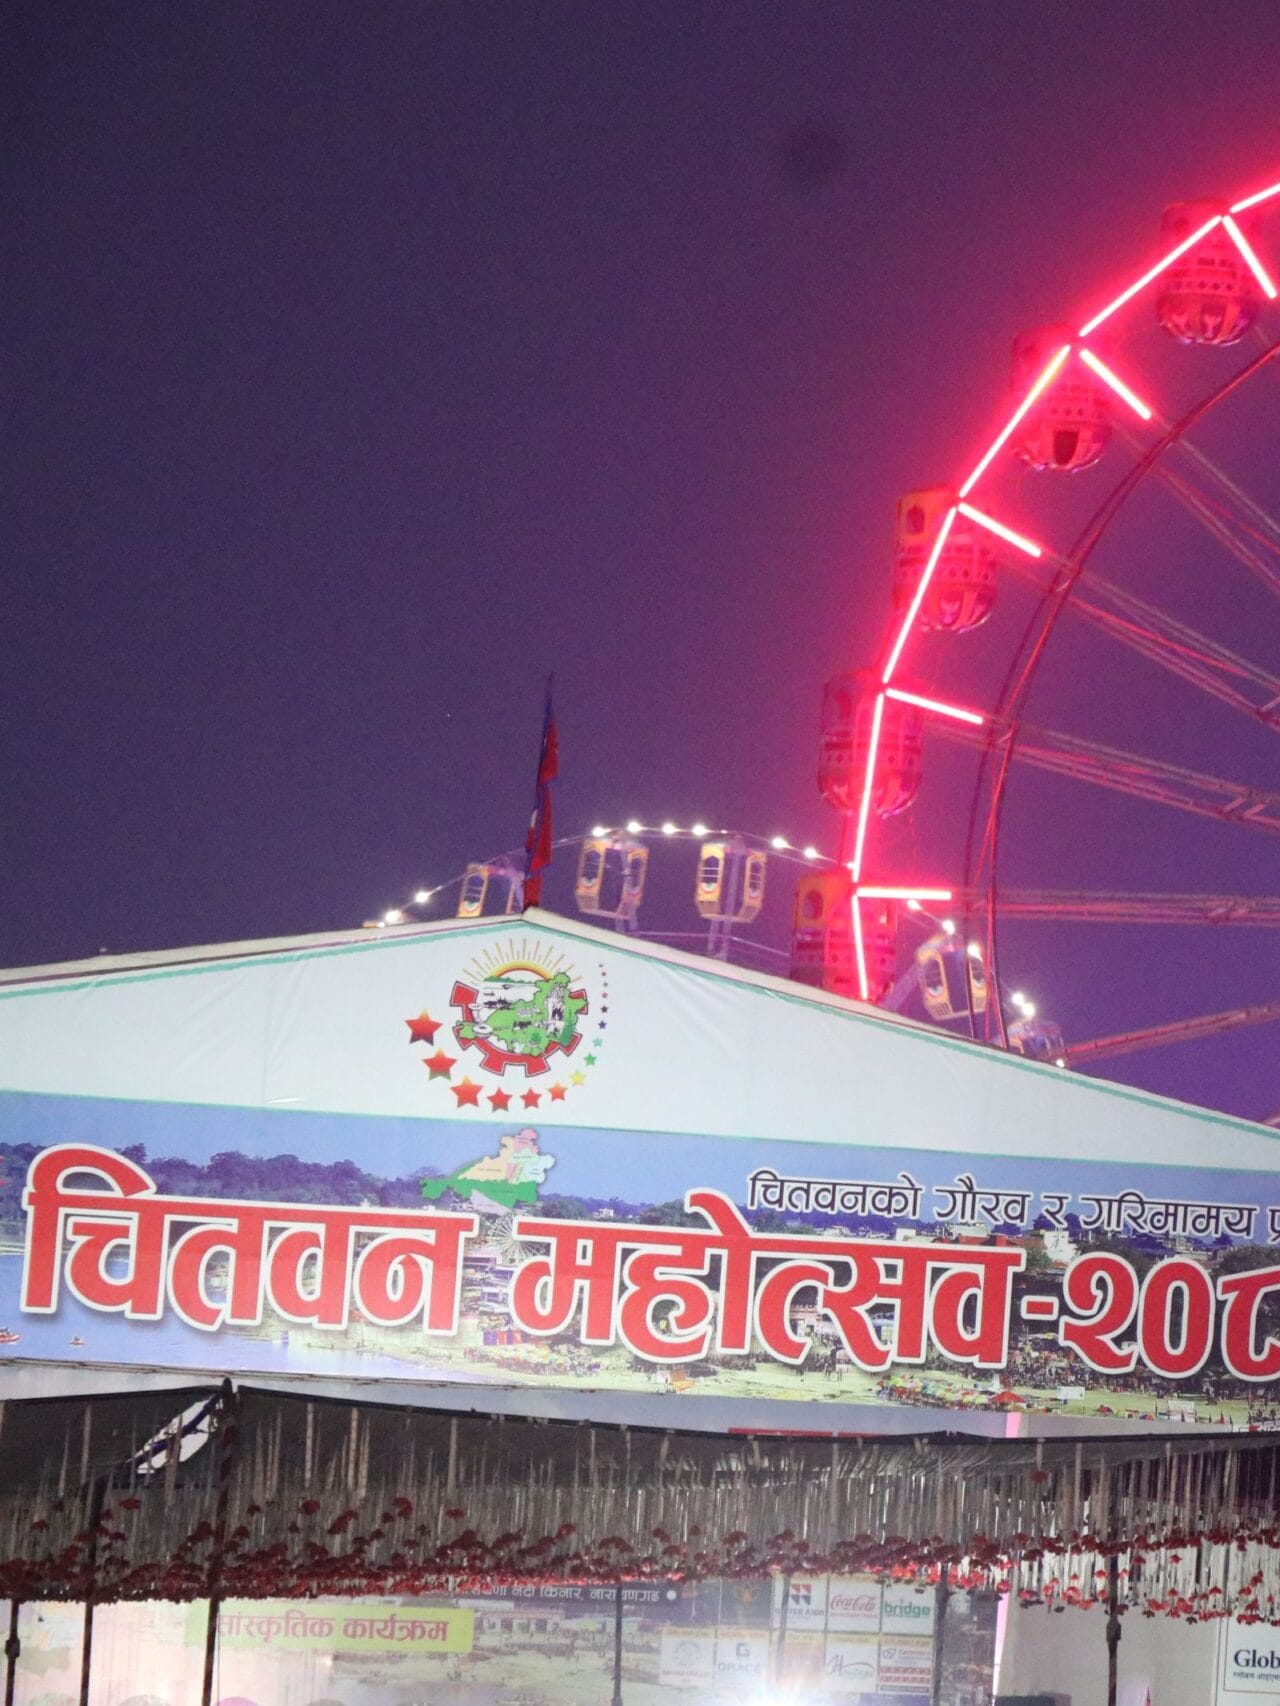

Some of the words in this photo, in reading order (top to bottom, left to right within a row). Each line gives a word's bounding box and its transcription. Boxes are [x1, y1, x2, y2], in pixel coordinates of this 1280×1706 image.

[748, 1168, 923, 1218] चितवनको
[934, 1175, 1031, 1225] गौरव
[1043, 1194, 1070, 1228] र
[1080, 1191, 1258, 1238] गरिमामय
[24, 1145, 477, 1333] चितवन
[342, 1612, 450, 1642] कार्यक्रम
[884, 1599, 931, 1618] bridge
